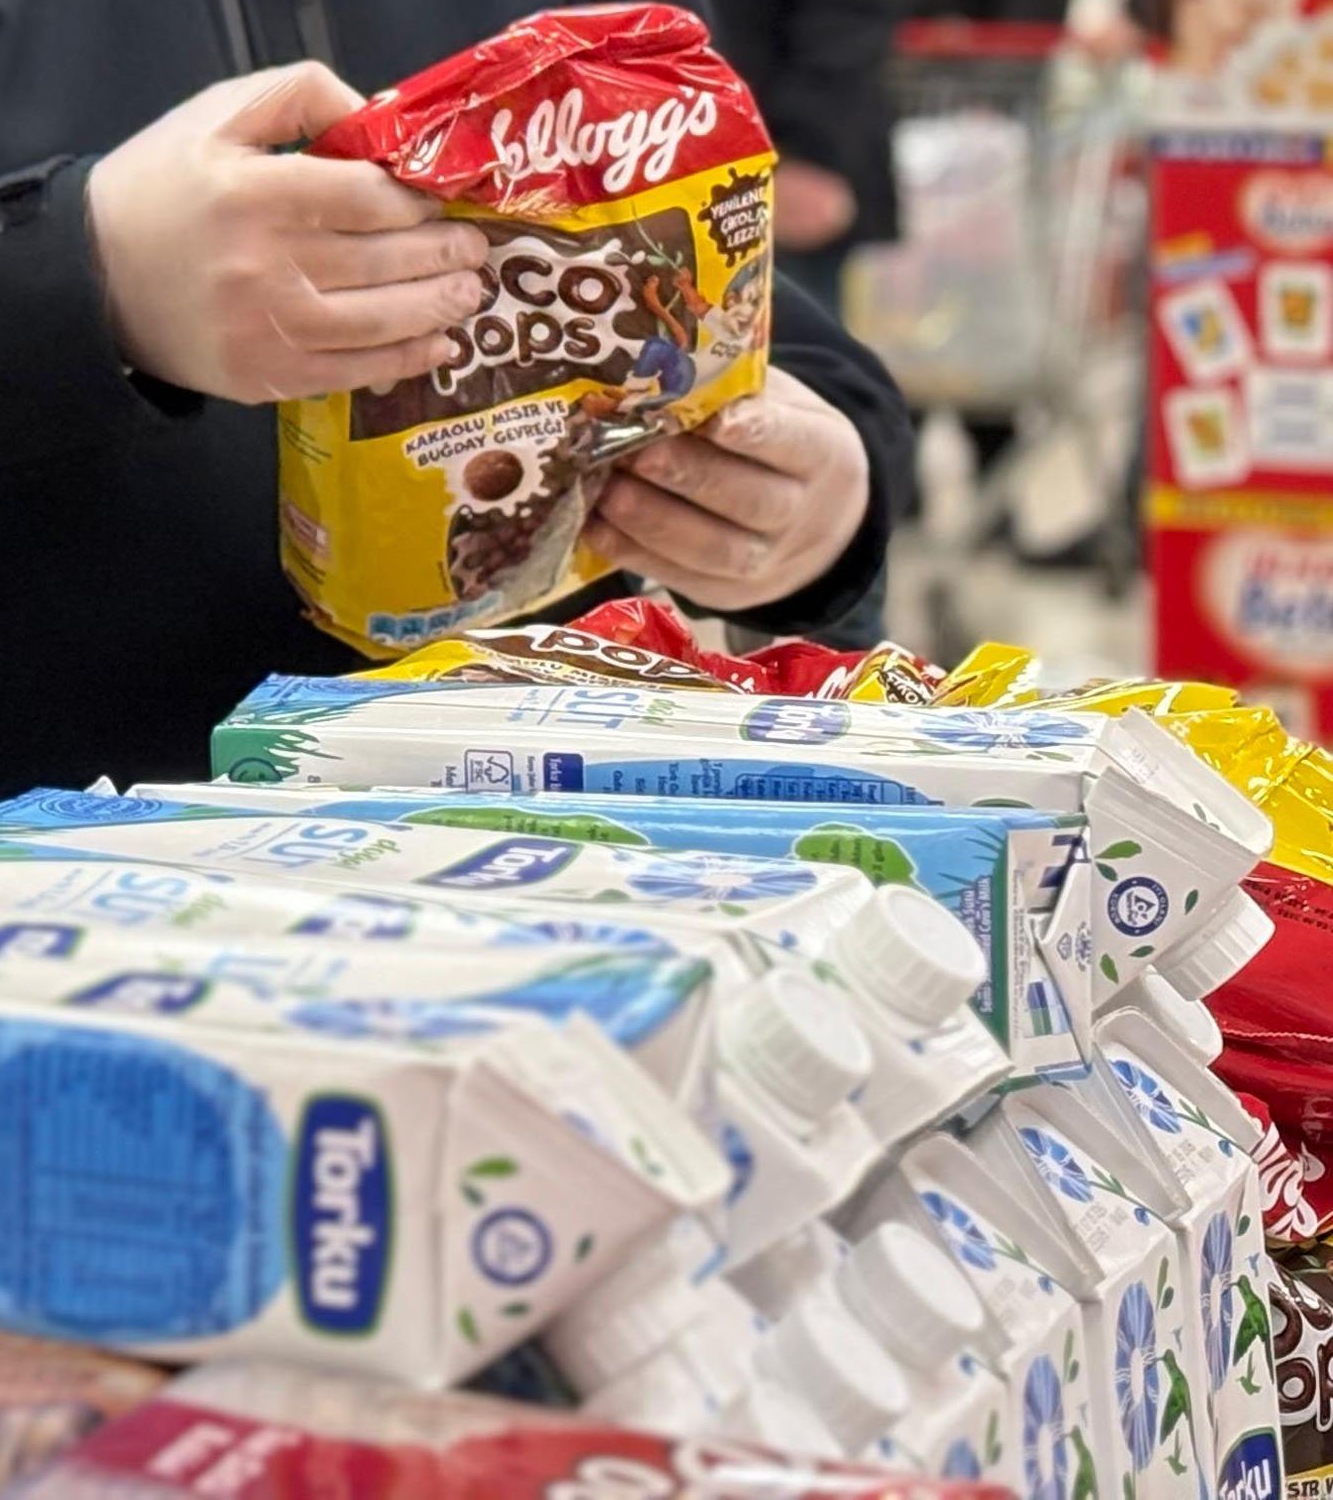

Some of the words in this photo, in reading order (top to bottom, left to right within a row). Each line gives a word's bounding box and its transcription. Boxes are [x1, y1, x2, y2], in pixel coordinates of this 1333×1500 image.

[491, 85, 718, 194] Kellogg's
[479, 255, 623, 315] co
[406, 417, 485, 455] KAKAOLU
[492, 402, 542, 425] MISIR
[545, 399, 567, 415] VE
[417, 434, 487, 467] BUĞDAY
[536, 630, 705, 681] pop
[312, 1116, 376, 1309] Torku
[1287, 1480, 1320, 1498] SIR
